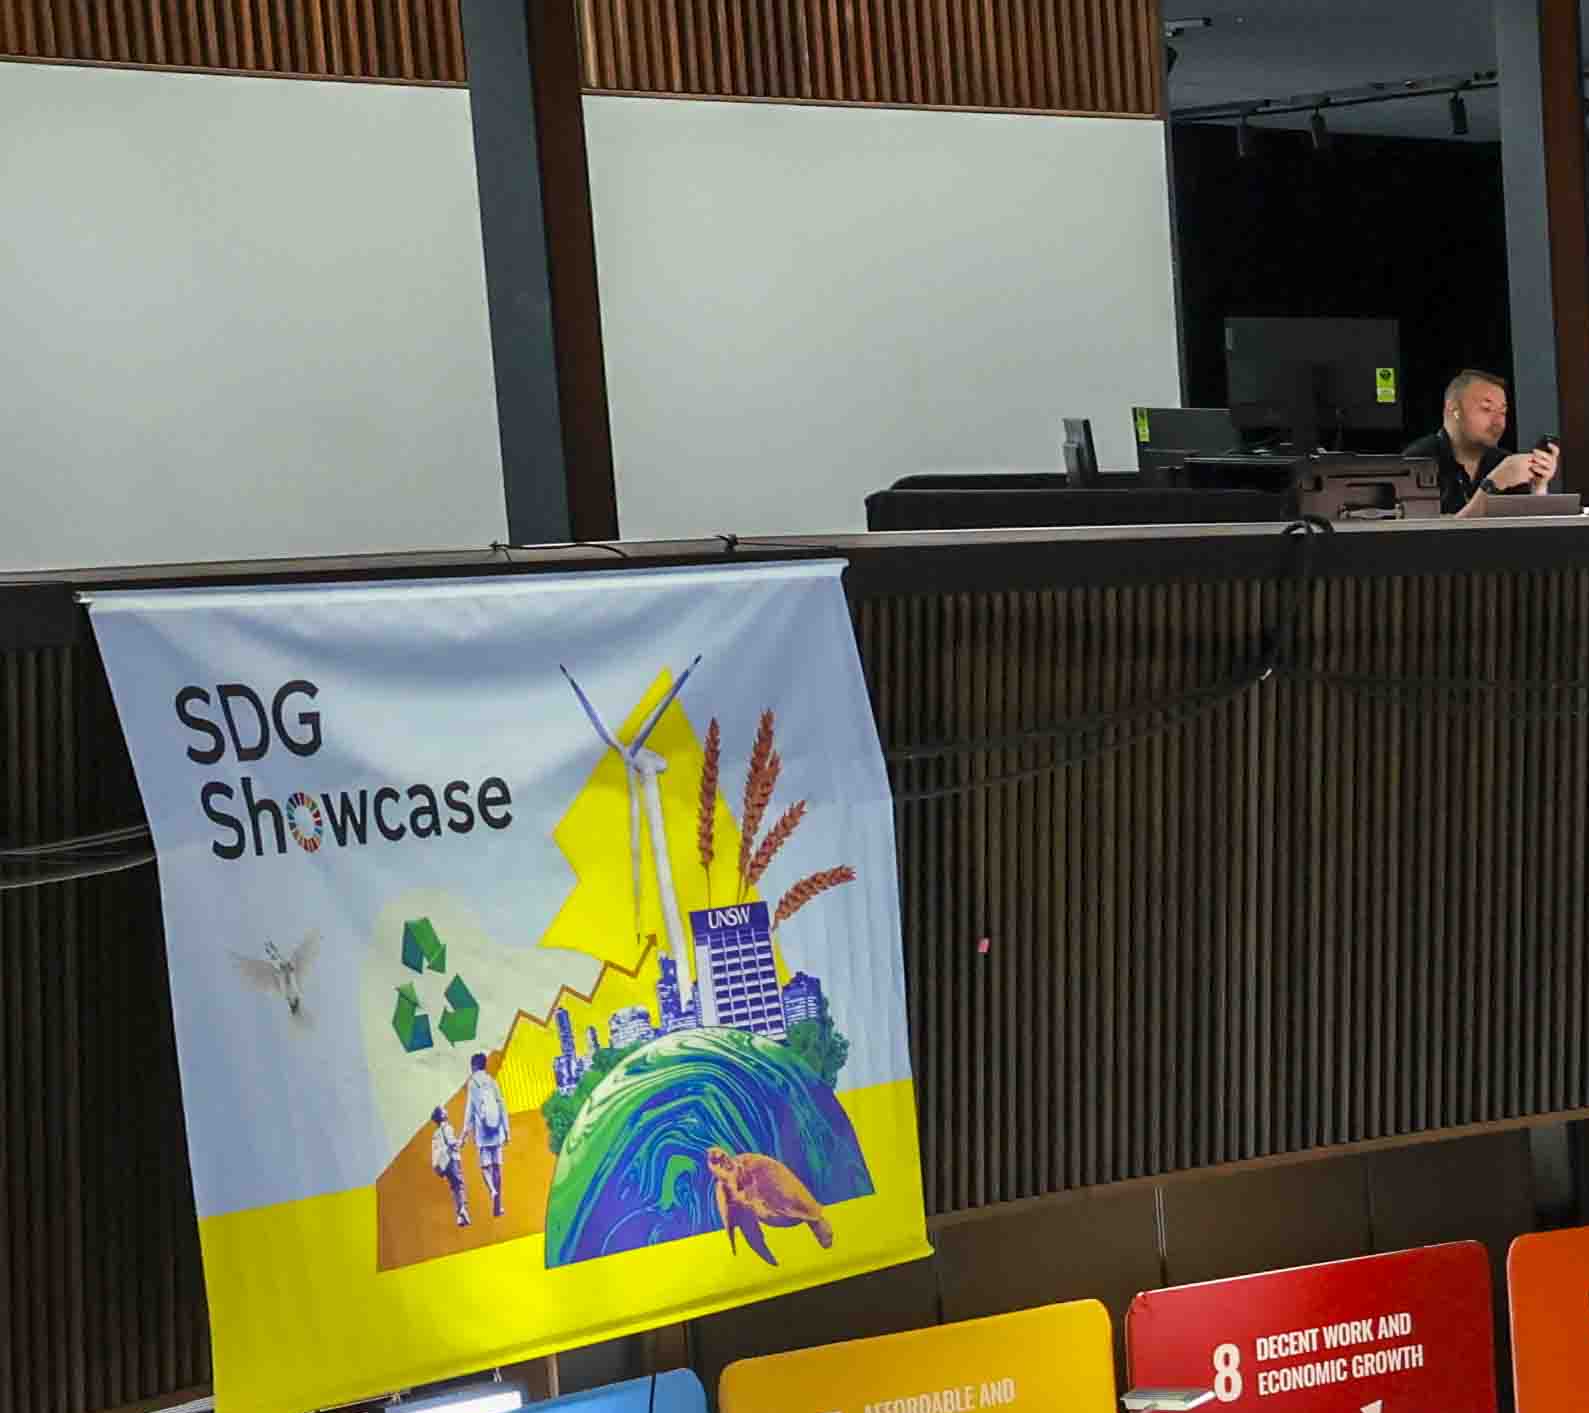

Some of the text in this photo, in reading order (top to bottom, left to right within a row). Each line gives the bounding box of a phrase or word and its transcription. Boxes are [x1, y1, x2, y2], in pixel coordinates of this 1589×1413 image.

[175, 680, 322, 765] SDG
[201, 776, 513, 860] Showcase
[708, 905, 751, 929] UNSW
[1255, 1312, 1412, 1361] DECENT WORK AND
[979, 1377, 1017, 1409] AND
[1213, 1343, 1243, 1402] 8
[1258, 1343, 1424, 1397] ECONOMIC GROWTH
